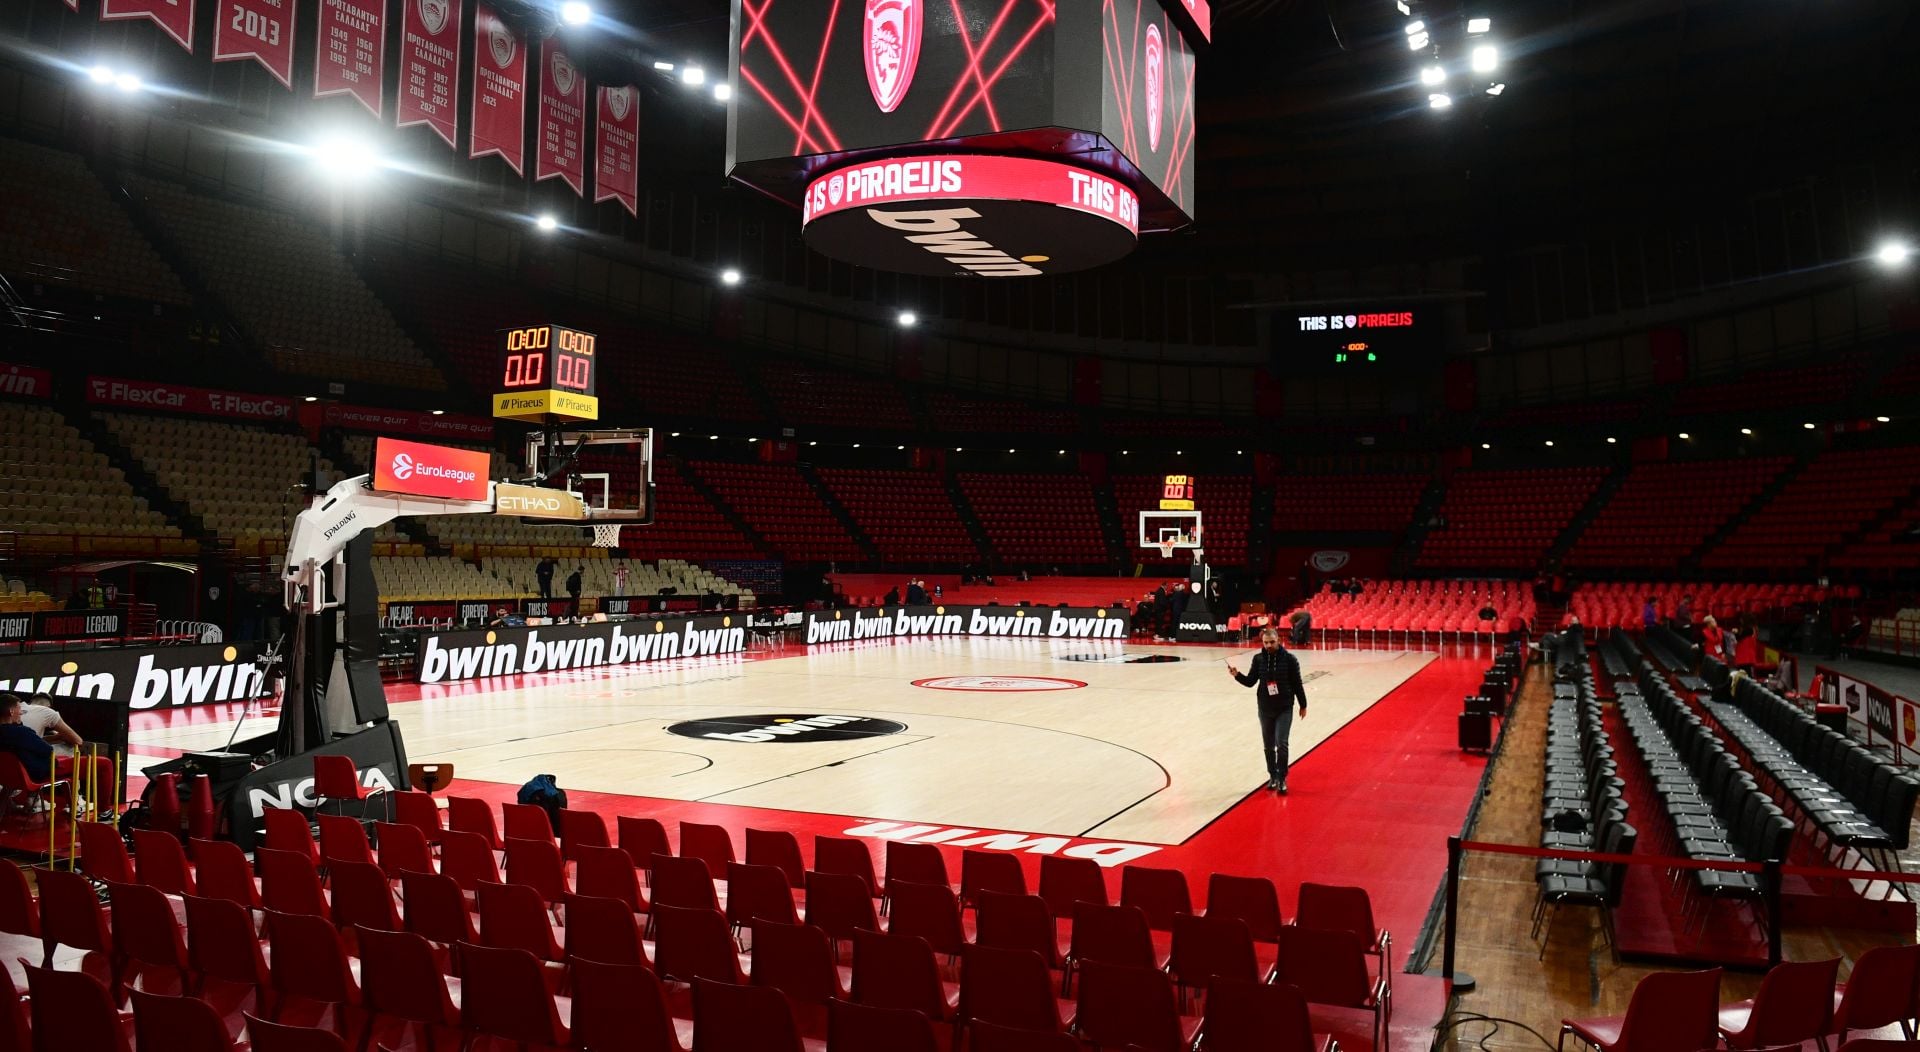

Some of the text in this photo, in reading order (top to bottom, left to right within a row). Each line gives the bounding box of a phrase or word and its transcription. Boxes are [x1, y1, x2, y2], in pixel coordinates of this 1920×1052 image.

[232, 4, 280, 46] 2013
[335, 11, 370, 33] ΕΛΛΑΔΑΣ
[330, 39, 347, 53] 1976
[331, 26, 373, 51] 1949 1960
[330, 51, 372, 76] 1993 1994
[415, 47, 446, 68] ΕΛΛΑΔΑΣ
[342, 68, 359, 83] 1995
[410, 74, 448, 96] 2012 2015
[411, 62, 448, 84] 1996 1997
[410, 86, 448, 107] 2016 2022
[420, 102, 436, 114] 2023
[482, 94, 497, 107] 2025
[813, 180, 827, 214] IS
[1068, 171, 1132, 223] THIS IS
[867, 207, 1050, 277] bwin
[1299, 316, 1327, 330] THIS
[1331, 315, 1344, 329] IS
[507, 327, 549, 351] 10:00
[559, 330, 595, 356] 10:00
[504, 352, 544, 387] 0.0
[556, 354, 590, 389] 0.0
[111, 383, 186, 407] FlexCar
[225, 395, 291, 418] FlexCar
[511, 398, 544, 410] Piraeus
[565, 398, 593, 413] Piraeus
[343, 412, 409, 425] NEVER QUIT
[434, 421, 494, 433] NEVER QUIT
[416, 462, 476, 484] EuroLeague
[498, 495, 561, 512] ETIHAD
[323, 510, 357, 542] SPALDING
[389, 606, 400, 620] WE
[462, 604, 489, 618] FOREVER
[528, 603, 540, 616] THIS
[541, 602, 548, 616] IS
[895, 606, 963, 636] bwin
[0, 618, 29, 637] FIGHT
[86, 615, 118, 634] LEGEND
[807, 610, 850, 644] bwin
[854, 608, 891, 640] bwin
[969, 608, 1041, 637] bwin
[1048, 608, 1125, 639] bwin
[1179, 622, 1212, 631] NOVA
[609, 621, 678, 665] bwin
[682, 616, 744, 657] bwin
[420, 630, 518, 684] bwin
[523, 628, 605, 673] bwin
[129, 646, 264, 709] bwin
[1868, 696, 1893, 731] NOVA
[702, 715, 866, 744] bwin
[249, 767, 396, 819] NOA
[843, 819, 1164, 868] bwin
